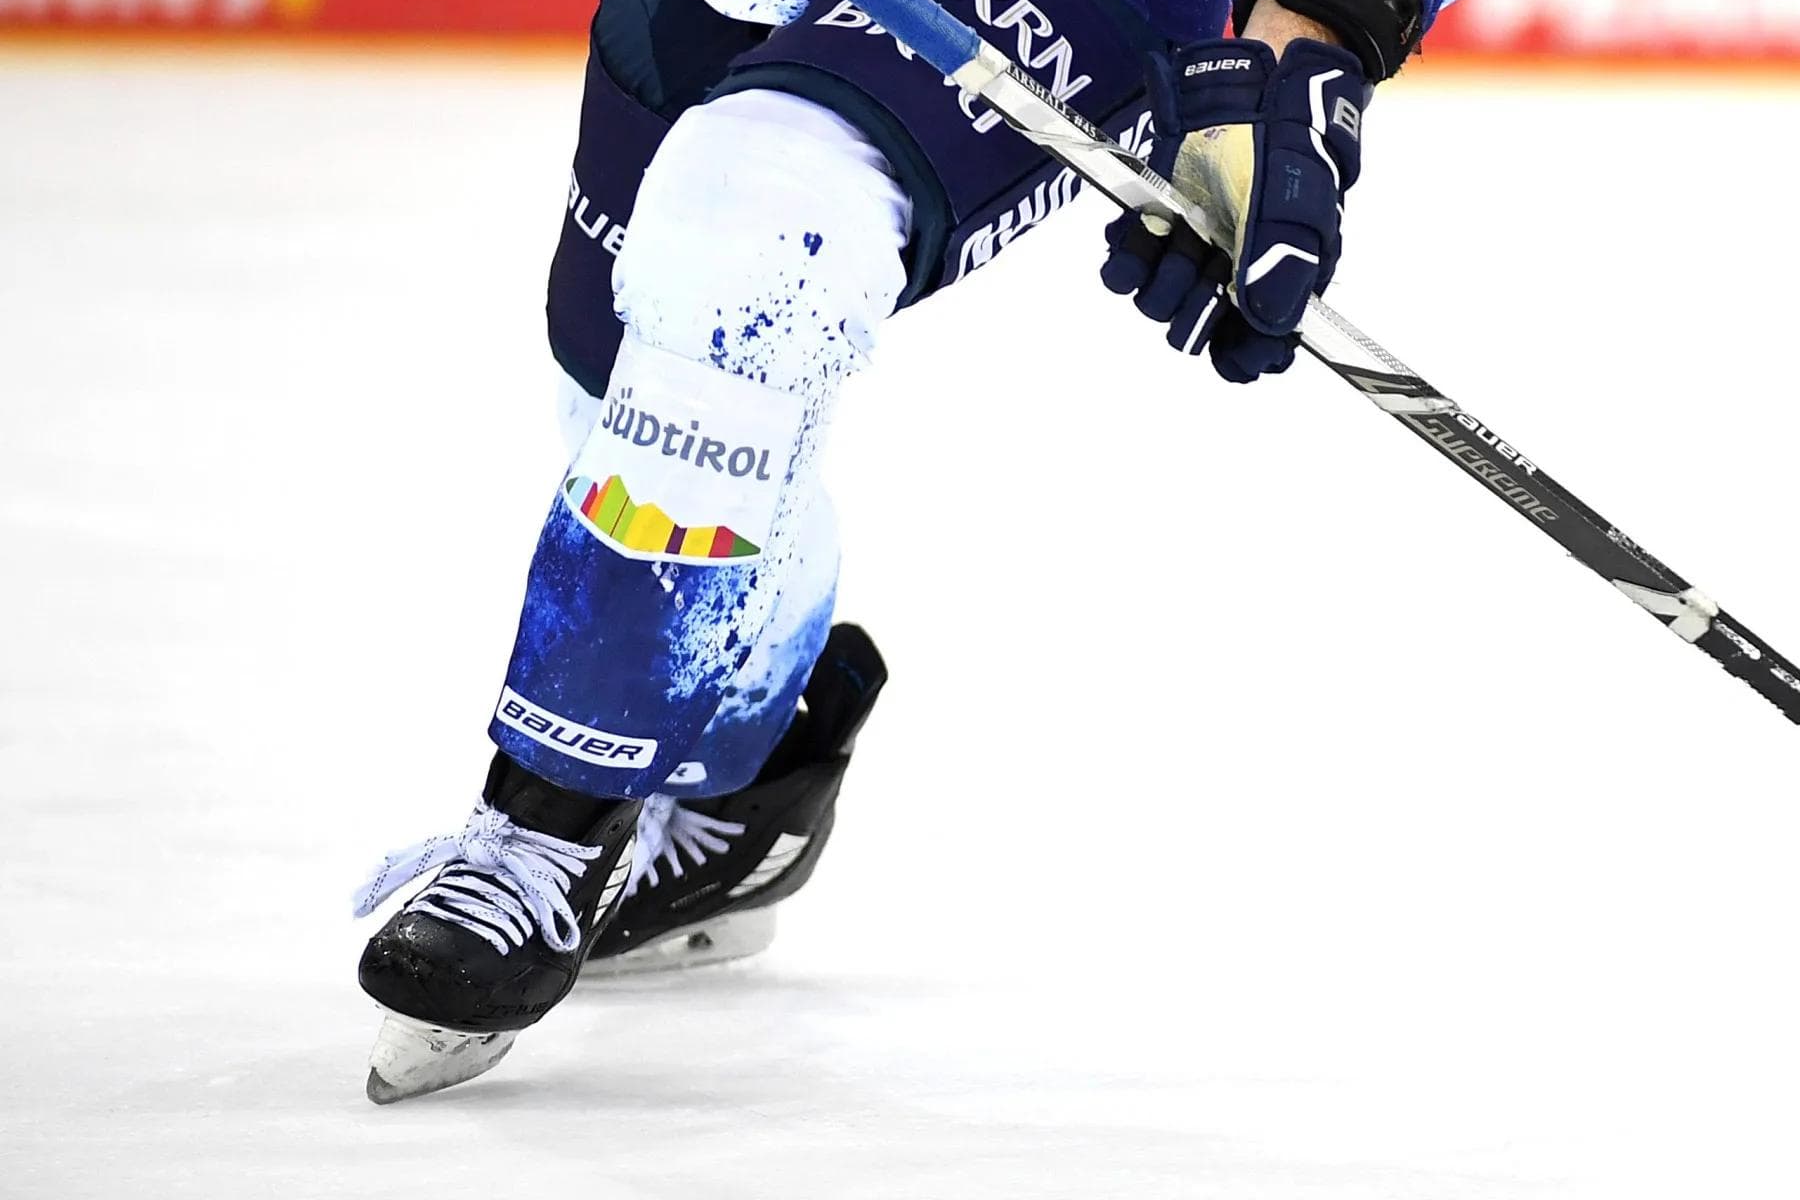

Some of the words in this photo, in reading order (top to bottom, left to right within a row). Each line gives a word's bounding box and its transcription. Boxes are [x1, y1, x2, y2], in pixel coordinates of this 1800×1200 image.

[1184, 58, 1252, 77] BAUER
[1422, 414, 1560, 524] SUPREME
[501, 700, 643, 762] BAUER
